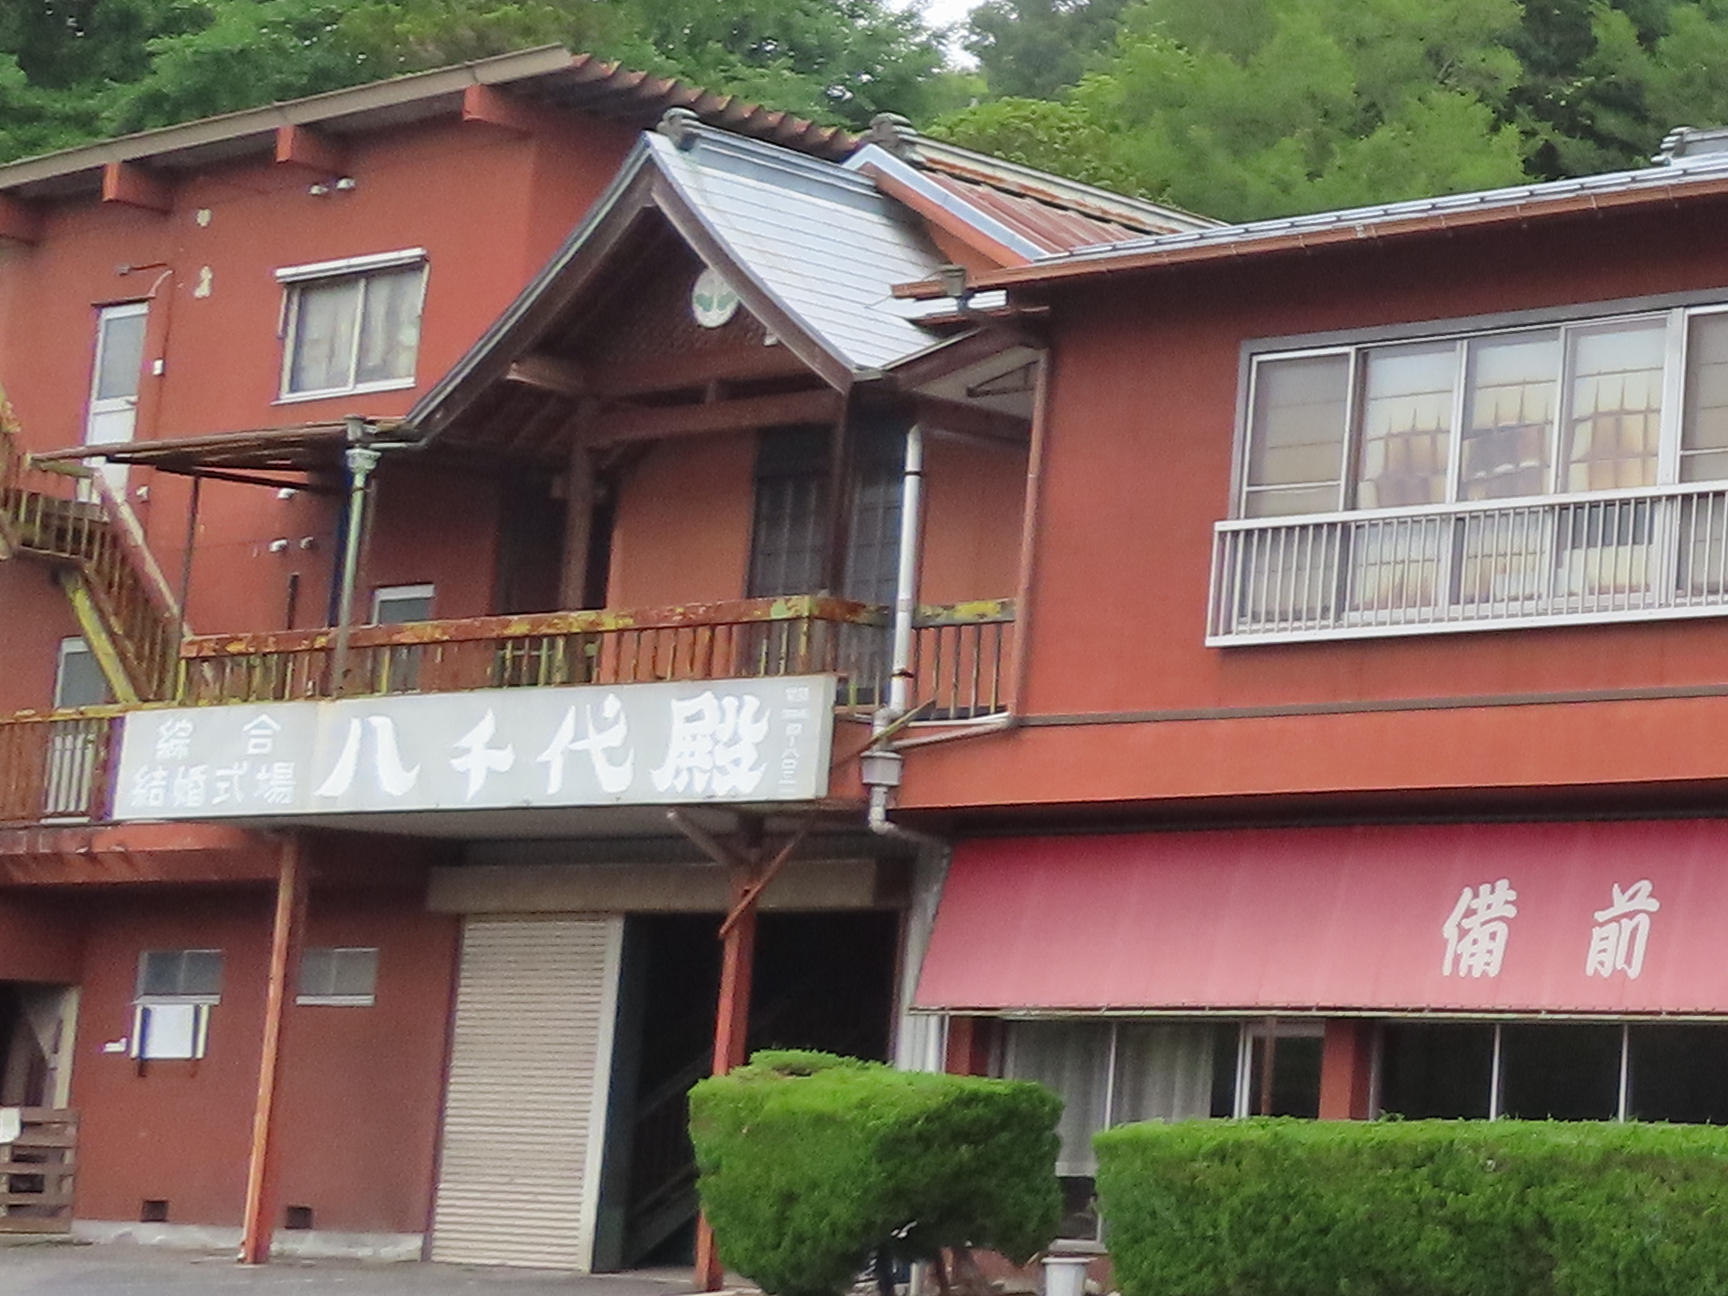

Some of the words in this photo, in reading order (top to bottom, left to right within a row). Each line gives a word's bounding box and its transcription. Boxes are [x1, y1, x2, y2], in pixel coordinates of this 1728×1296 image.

[131, 761, 296, 805] 結婚式場
[313, 690, 771, 802] 八千代殿
